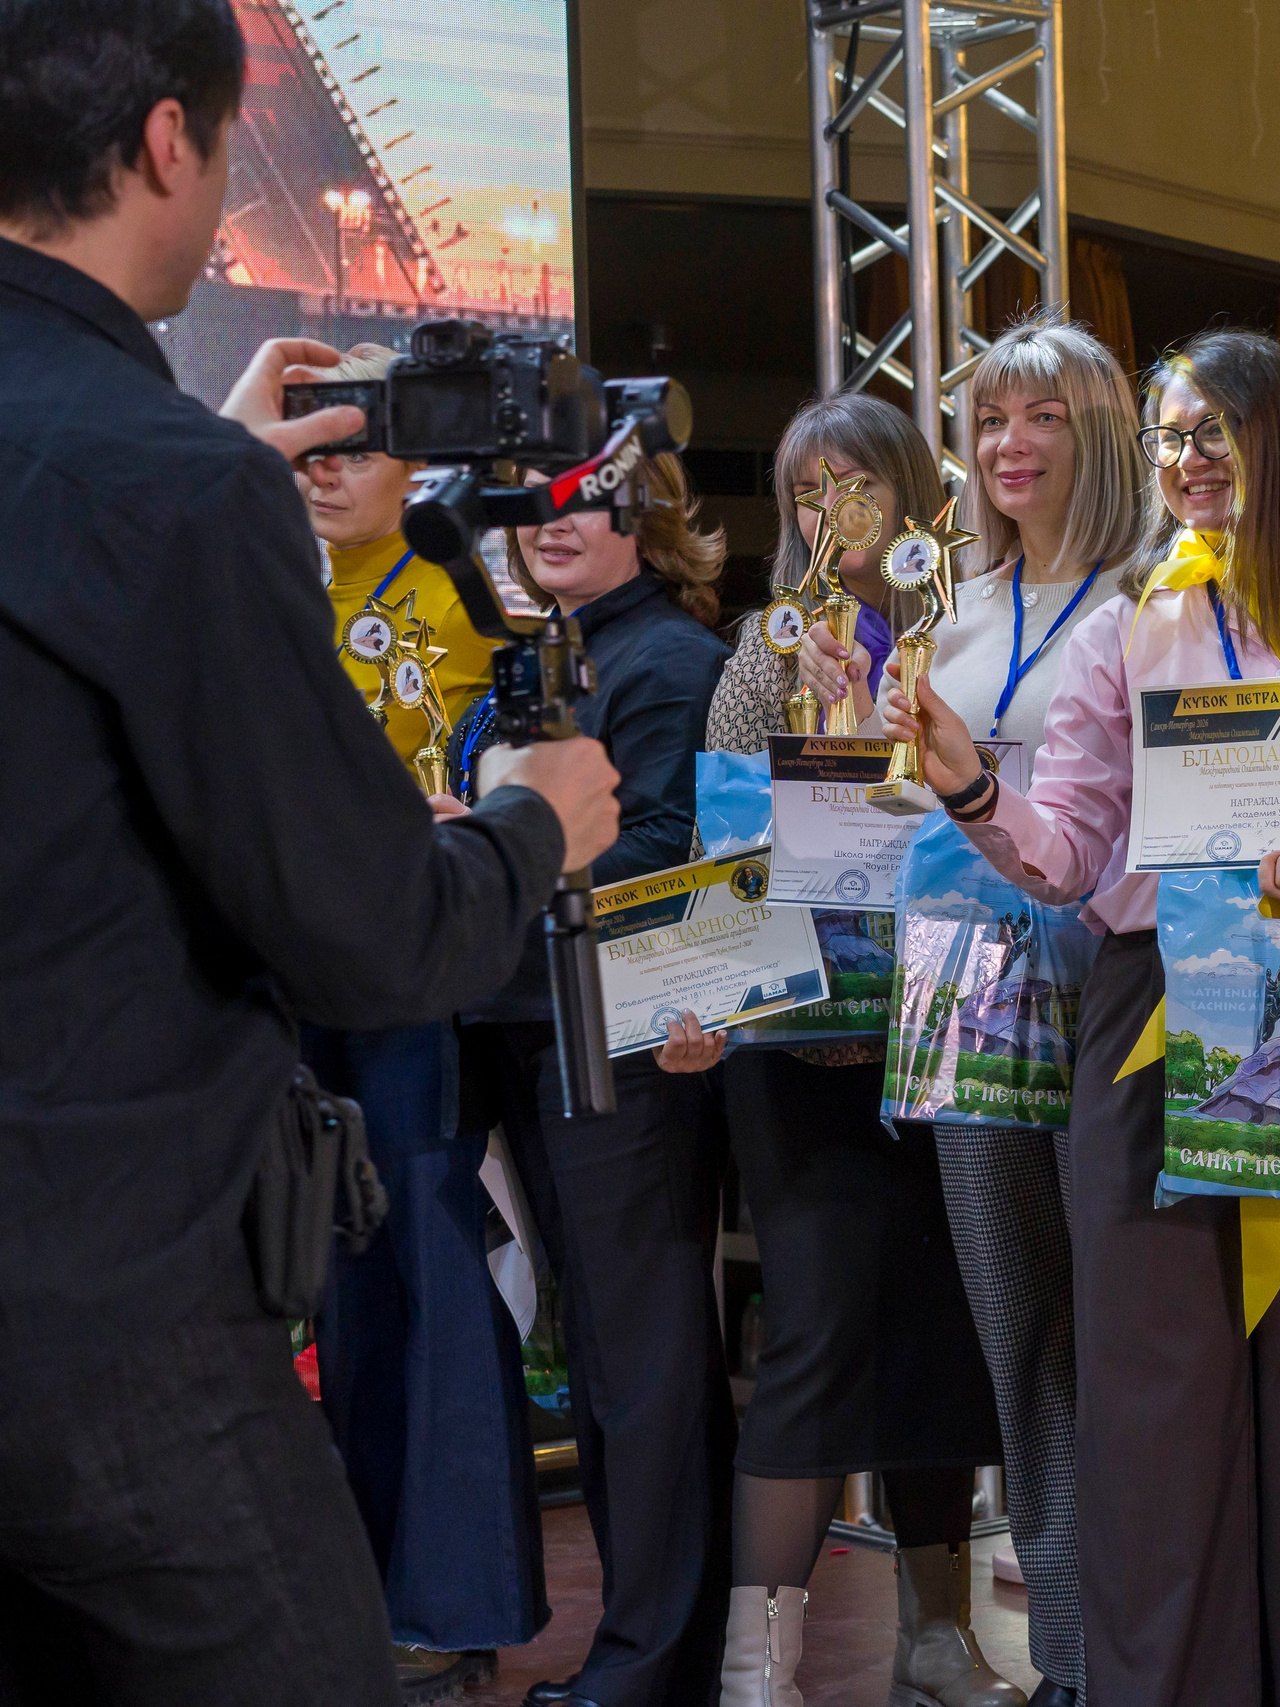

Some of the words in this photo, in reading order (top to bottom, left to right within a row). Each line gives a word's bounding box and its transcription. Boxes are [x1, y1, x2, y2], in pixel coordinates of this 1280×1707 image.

[579, 435, 643, 501] RONIN
[1183, 695, 1228, 709] КУБОК
[1236, 691, 1279, 706] ПЕТРА
[810, 740, 855, 752] КУБОК
[864, 741, 893, 752] ПЕТ
[1231, 810, 1277, 818] Академия
[834, 850, 863, 858] Школа
[866, 852, 903, 861] иностра
[596, 889, 639, 910] КУБОК
[645, 877, 686, 896] ПЕТРА
[692, 873, 697, 884] I
[606, 905, 772, 961] БЛАГОДАРНОСТЬ
[615, 990, 671, 1010] Объединение
[672, 976, 723, 994] "Ментальная
[725, 960, 781, 981] арифметика"
[662, 963, 729, 986] НАГРАЖДАЕТСЯ
[653, 997, 680, 1010] школы
[681, 994, 688, 1002] N
[690, 988, 707, 999] 1811
[716, 980, 747, 993] Москвы
[763, 988, 787, 998] UAMAP
